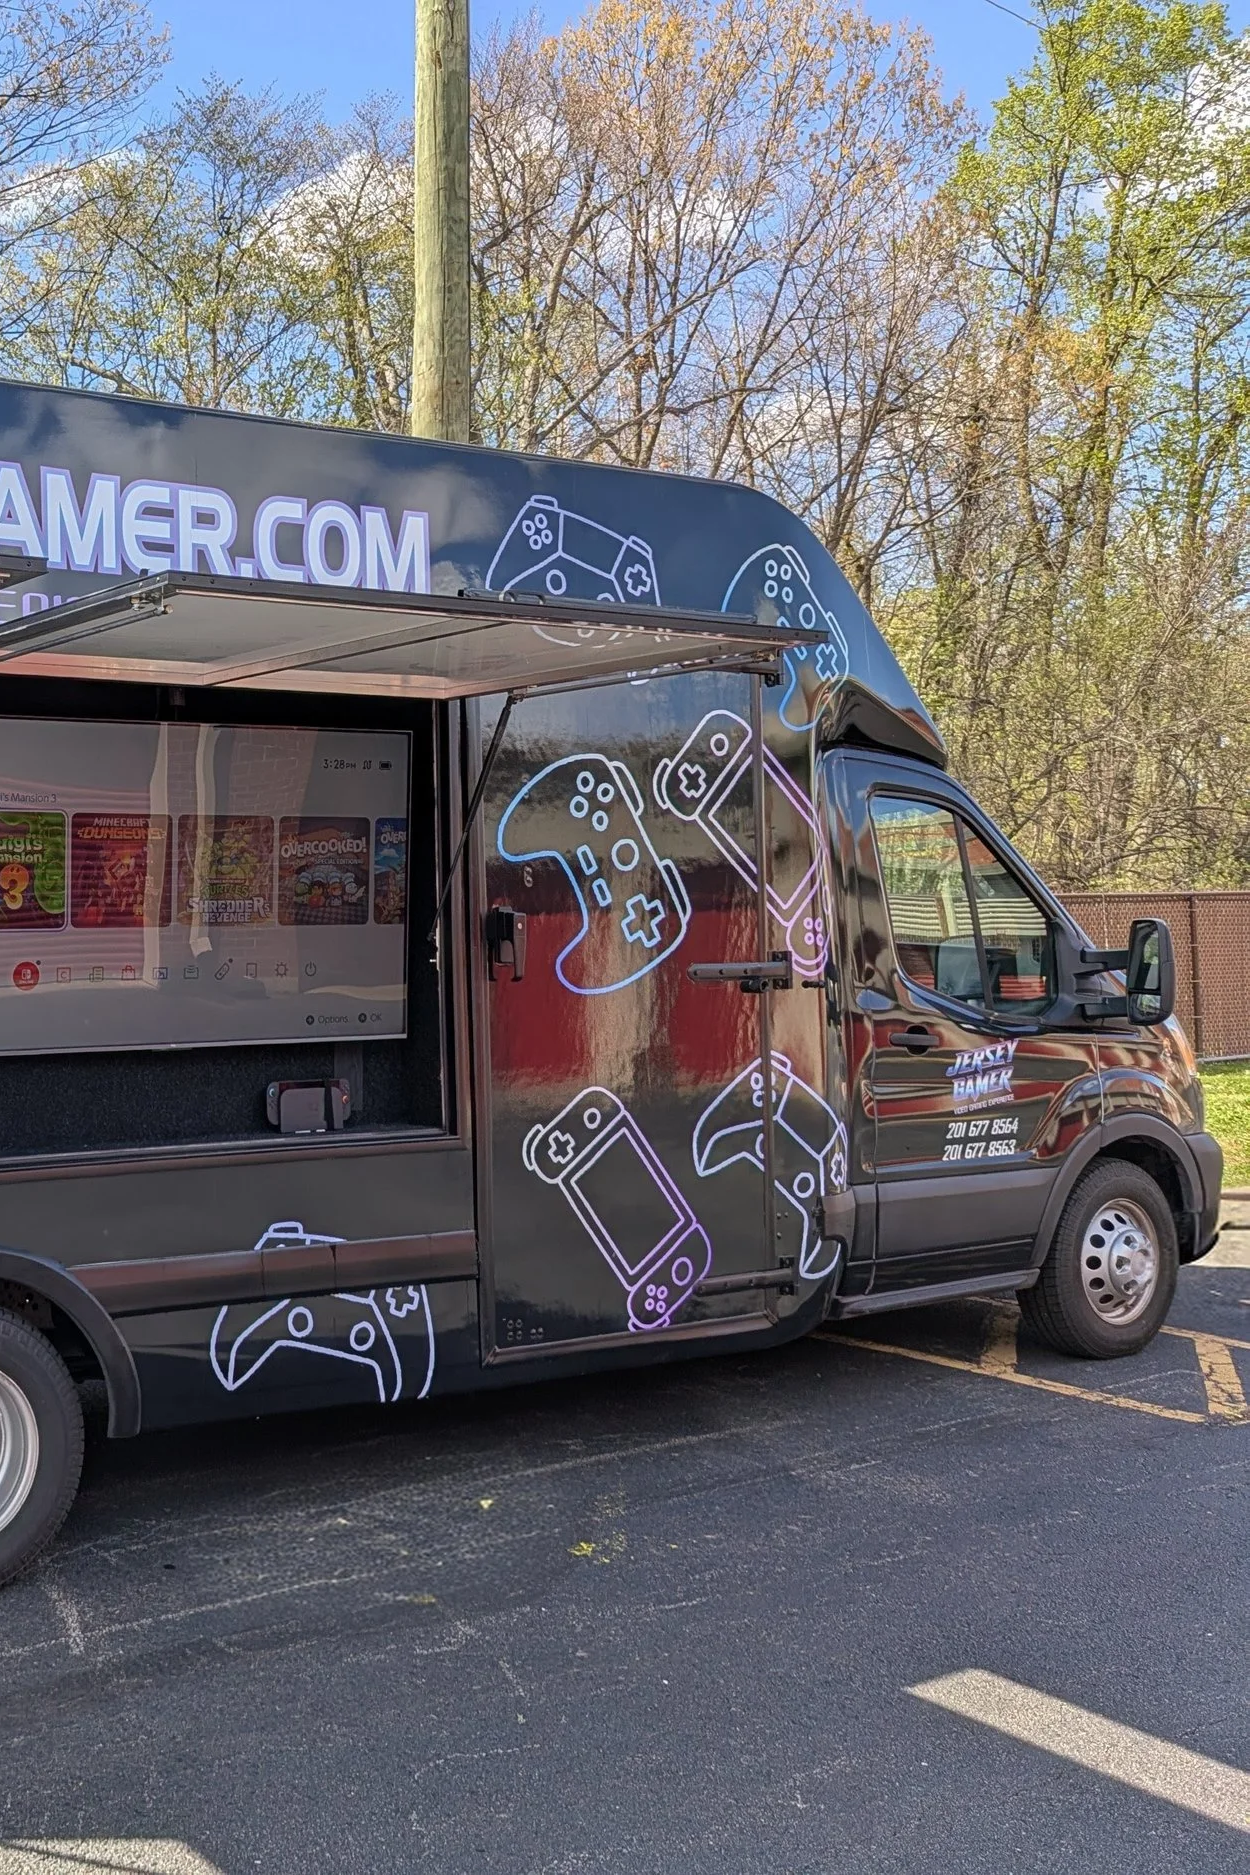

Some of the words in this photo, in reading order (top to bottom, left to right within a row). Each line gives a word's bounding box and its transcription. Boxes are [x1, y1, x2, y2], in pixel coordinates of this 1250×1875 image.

[11, 792, 49, 803] Mansion
[50, 793, 57, 803] 3
[92, 817, 152, 828] MINECRAFT
[79, 827, 164, 840] DUNGEONS
[280, 835, 368, 858] OVERCOOKED!
[0, 863, 30, 911] 3
[201, 912, 251, 923] REVENGE
[317, 1015, 349, 1025] Options
[370, 1013, 382, 1022] OK
[945, 1037, 1019, 1077] JERSEY
[952, 1065, 1014, 1102] GAMER
[945, 1121, 967, 1139] 201
[968, 1119, 990, 1137] 677
[991, 1117, 1019, 1135] 8564
[942, 1143, 963, 1161] 201
[964, 1141, 987, 1159] 677
[987, 1139, 1017, 1157] 8563
